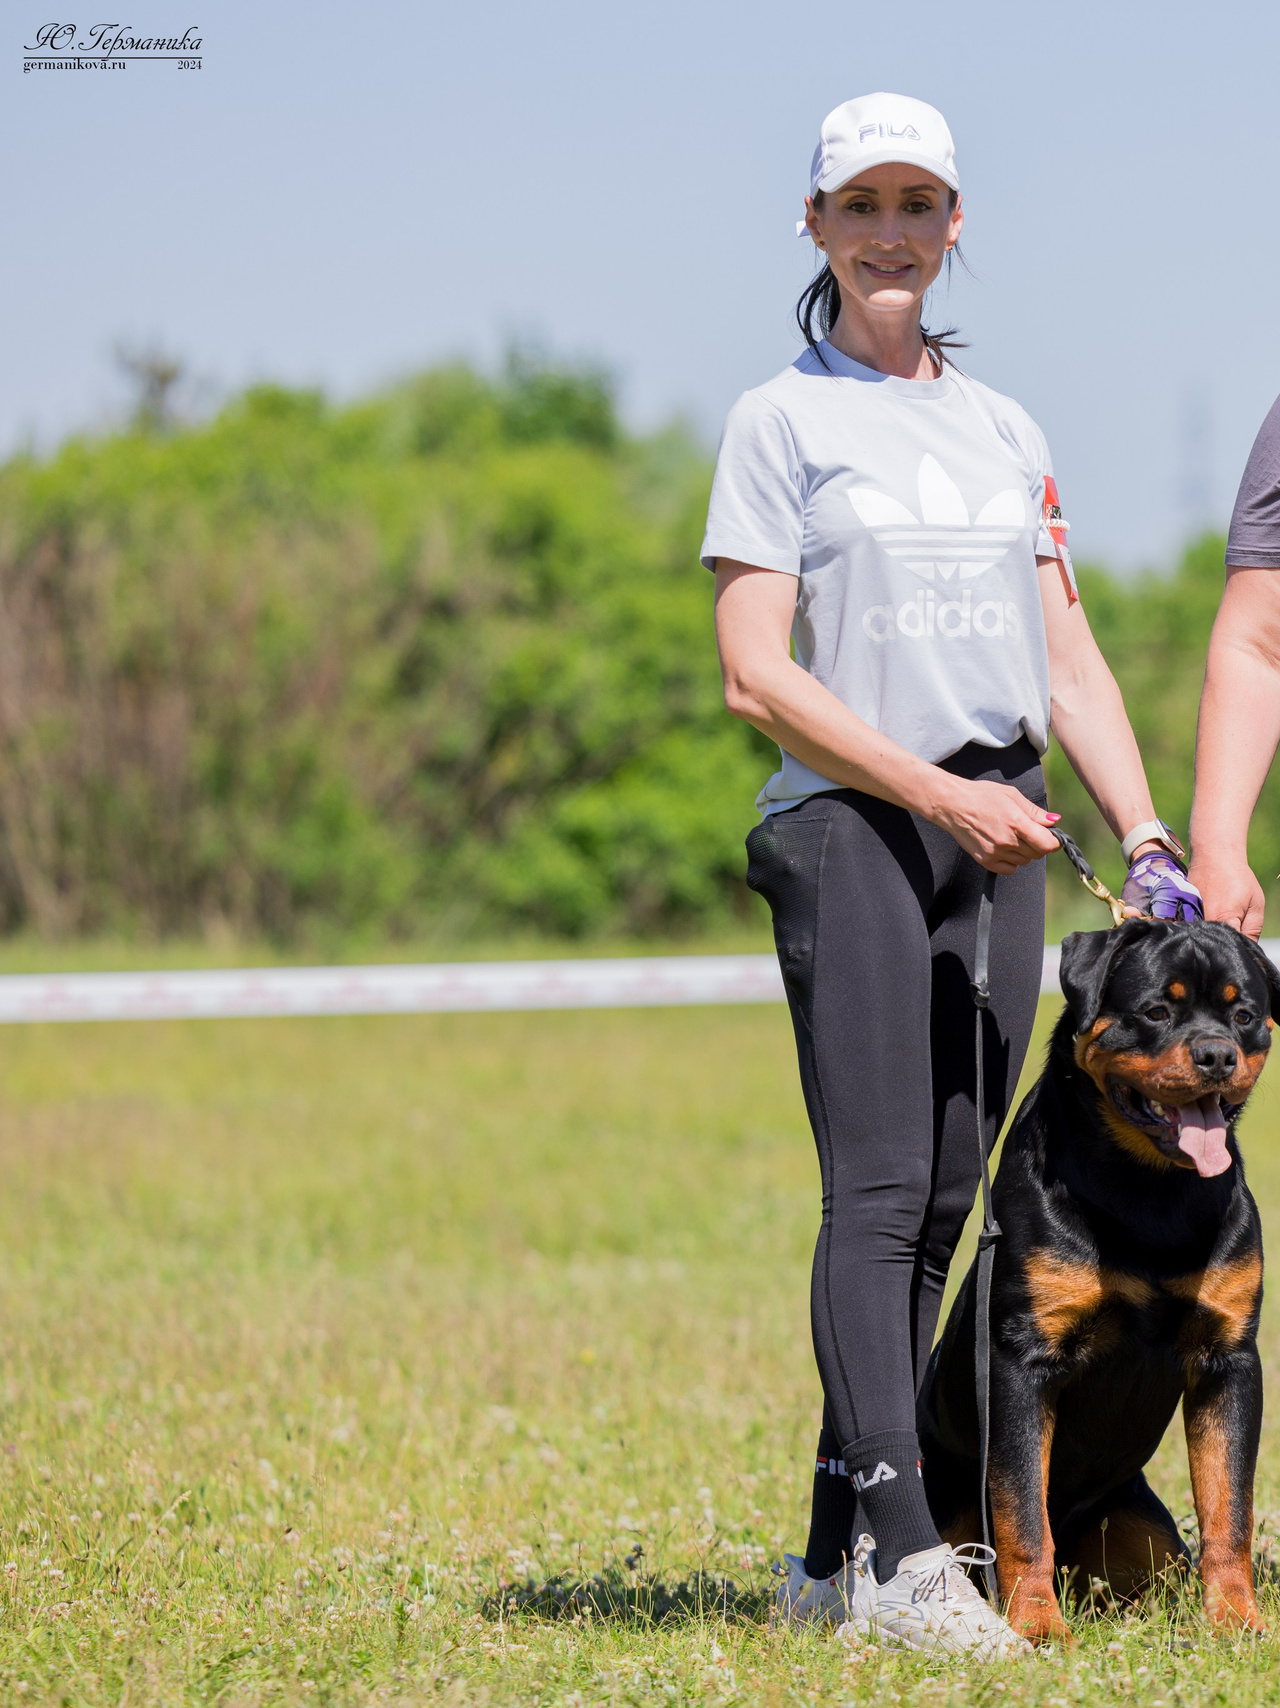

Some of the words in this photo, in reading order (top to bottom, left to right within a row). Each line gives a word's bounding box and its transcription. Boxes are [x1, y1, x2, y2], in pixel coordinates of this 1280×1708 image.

[858, 122, 921, 144] FILA
[861, 588, 1021, 643] adidas
[816, 1456, 850, 1477] FIL
